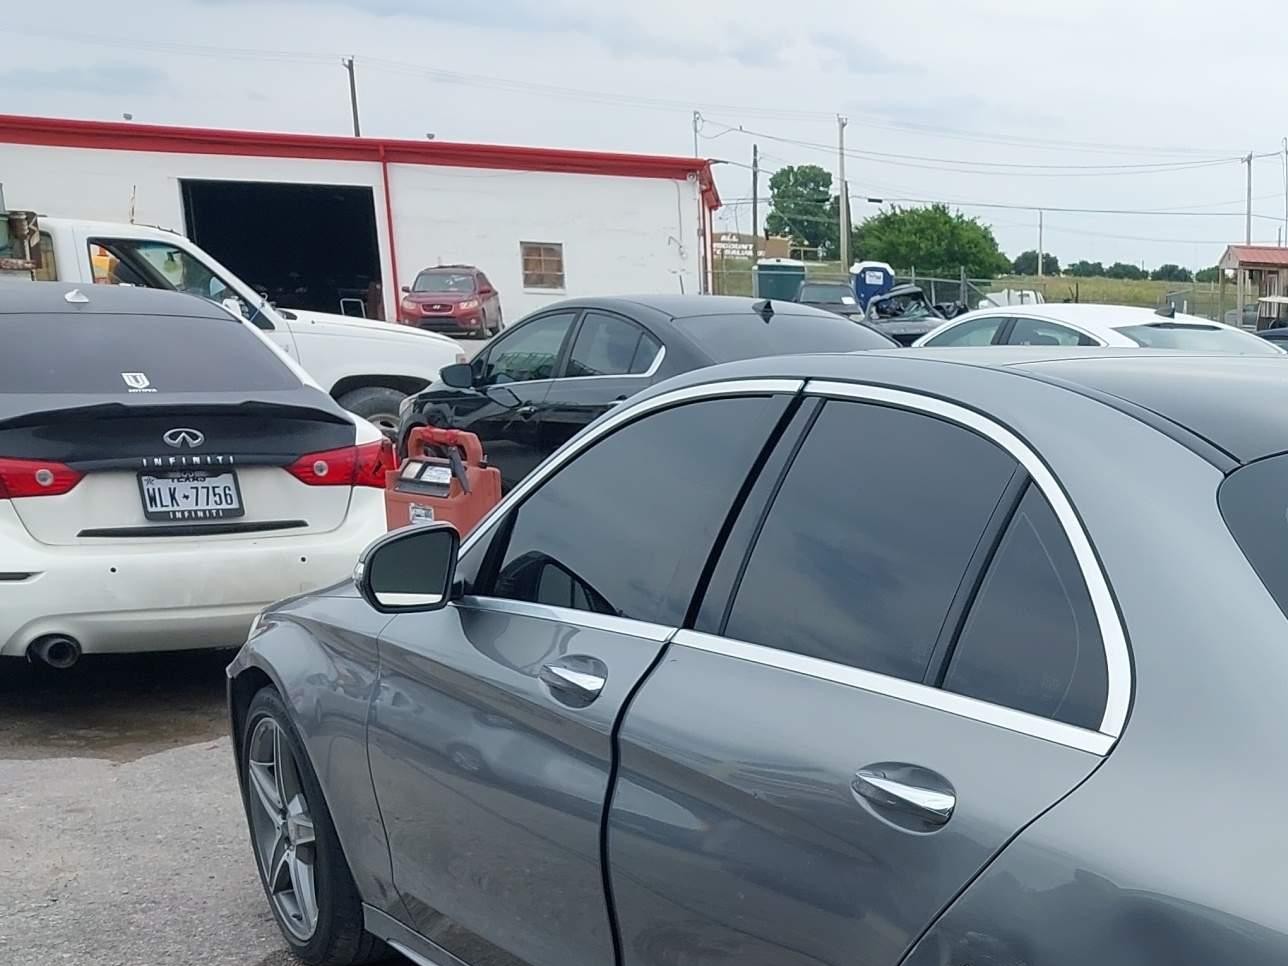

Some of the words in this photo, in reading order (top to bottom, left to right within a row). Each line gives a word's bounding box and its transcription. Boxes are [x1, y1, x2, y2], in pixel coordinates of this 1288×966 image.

[142, 455, 234, 467] INFINITI
[190, 486, 234, 507] 7756
[169, 509, 223, 519] INFINITI
